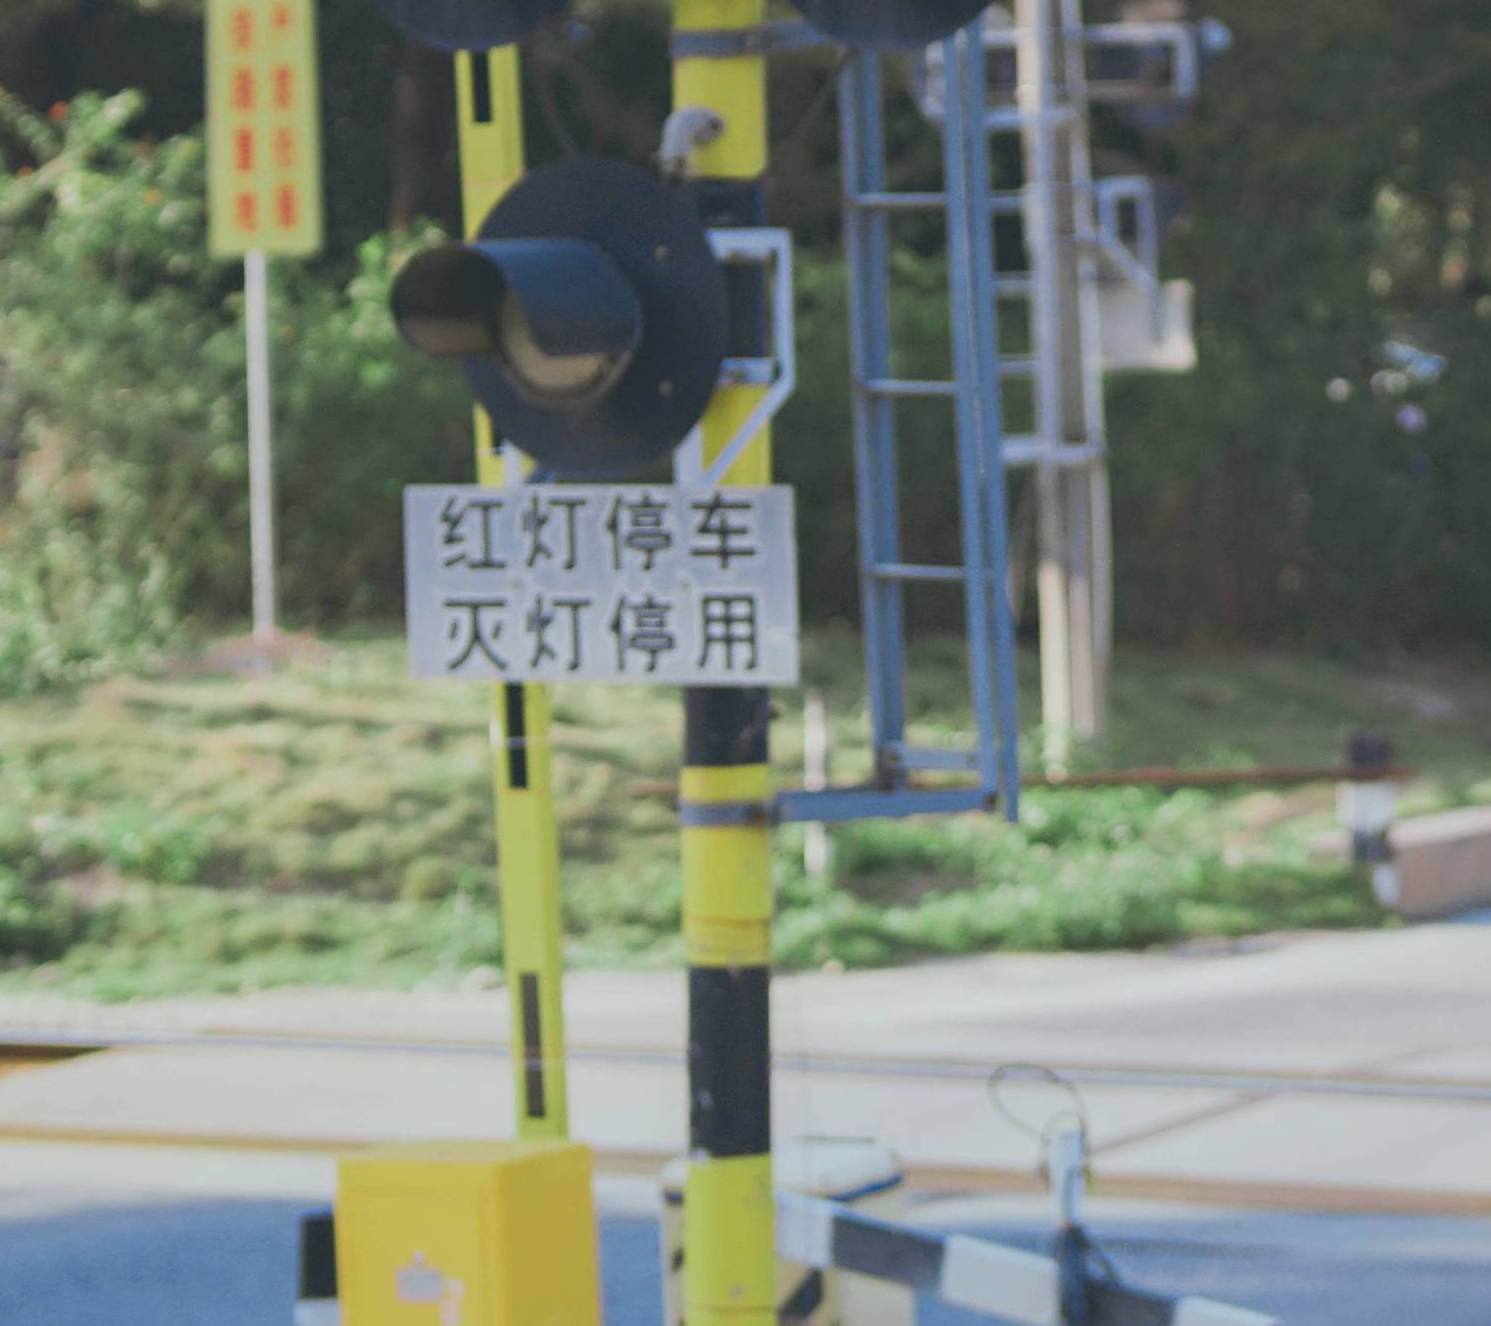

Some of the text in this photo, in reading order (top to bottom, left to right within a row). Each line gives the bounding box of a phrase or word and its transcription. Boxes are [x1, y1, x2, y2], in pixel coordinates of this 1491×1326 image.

[439, 490, 757, 571] 红灯停车
[443, 593, 759, 672] 灭灯停用
